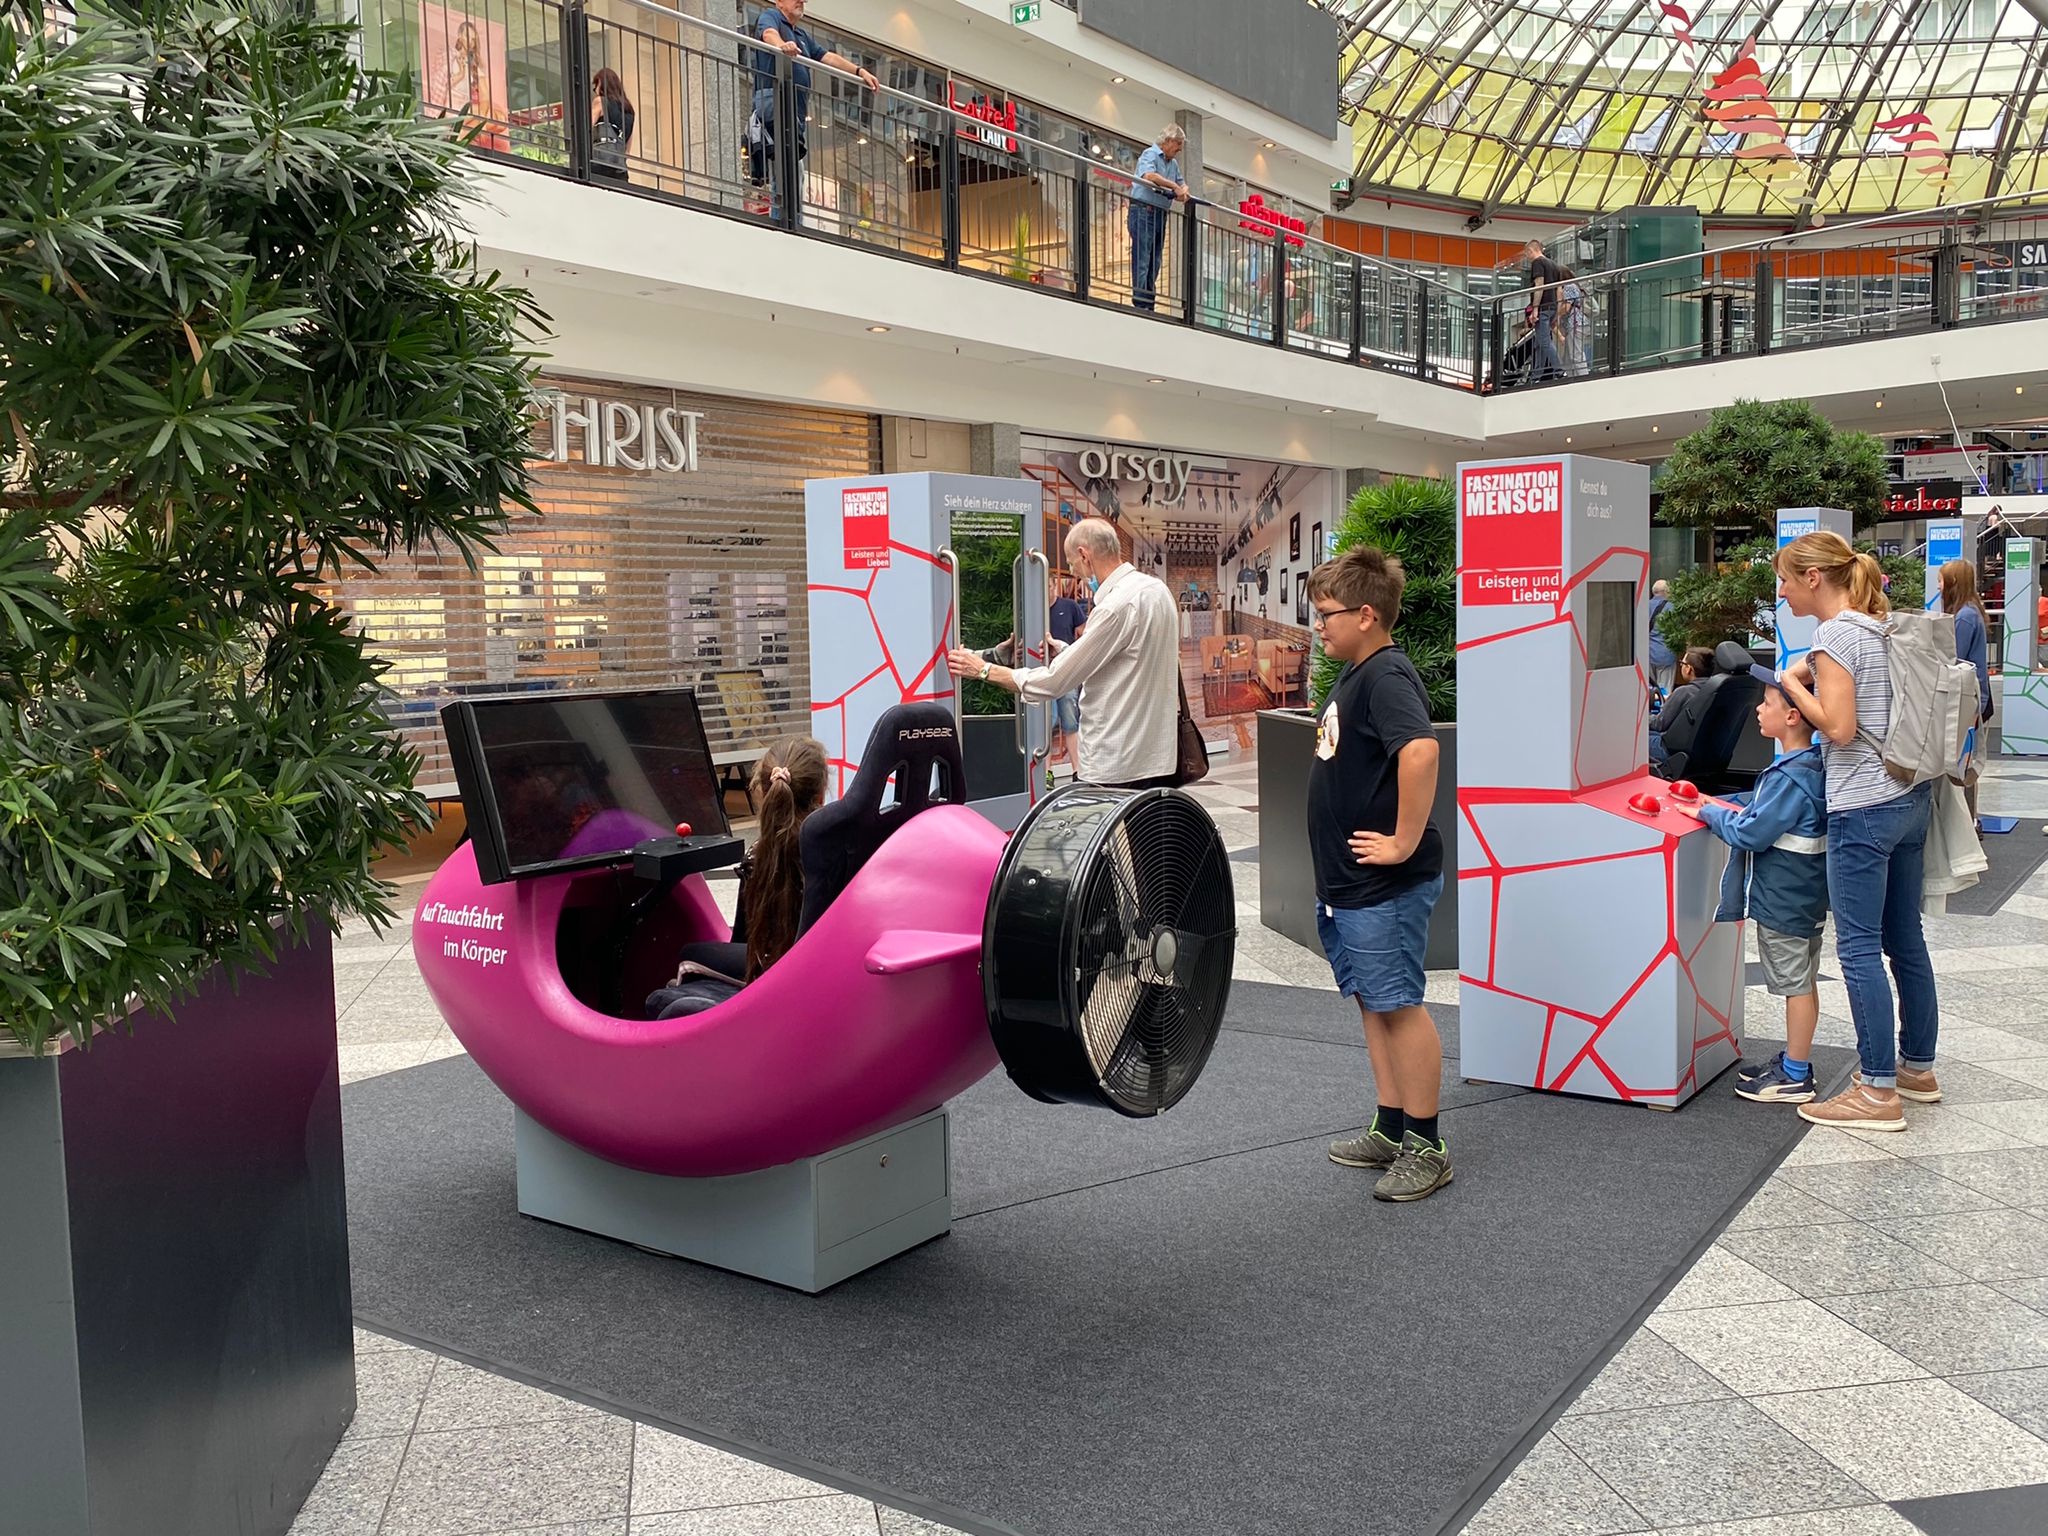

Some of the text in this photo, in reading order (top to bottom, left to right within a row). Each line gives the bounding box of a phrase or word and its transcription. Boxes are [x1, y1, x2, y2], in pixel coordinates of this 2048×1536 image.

[545, 395, 705, 473] HRIST
[1079, 450, 1193, 505] orsay
[1465, 470, 1559, 493] FASZINATION
[1580, 479, 1608, 496] Kennst du
[844, 491, 888, 503] FASZINATION
[944, 494, 1033, 514] Sieh dein Herz schlagen
[1465, 487, 1559, 517] MENSCH
[844, 502, 888, 517] MENSCH
[1586, 502, 1613, 519] dich aus?
[851, 549, 889, 559] Leisten und
[867, 558, 889, 567] Lieben
[1478, 573, 1560, 589] Leisten und
[1512, 589, 1560, 602] Lieben
[420, 902, 504, 931] Auf Tauchfahrt
[443, 935, 508, 967] im Körper
